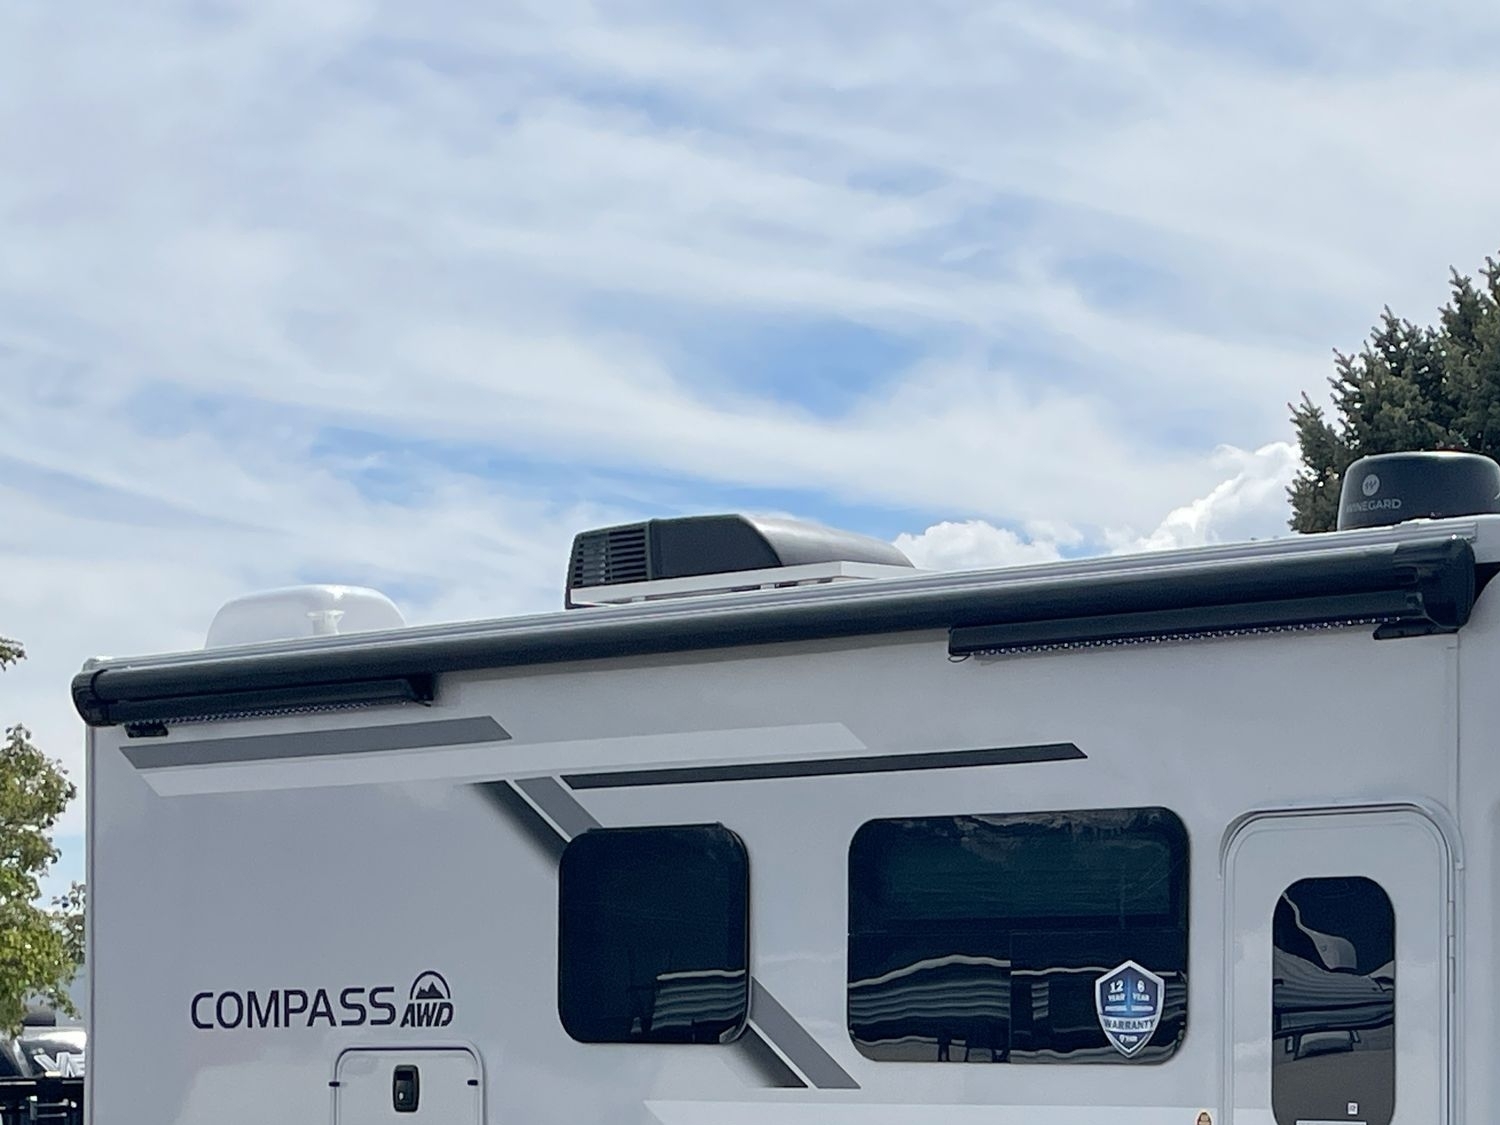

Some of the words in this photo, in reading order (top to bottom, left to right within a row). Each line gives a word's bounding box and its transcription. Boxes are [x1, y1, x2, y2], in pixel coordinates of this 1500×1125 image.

[1110, 980, 1124, 993] 12
[190, 986, 397, 1029] COMPASS
[400, 1002, 455, 1028] AWD
[1103, 1018, 1156, 1031] WARRANTY
